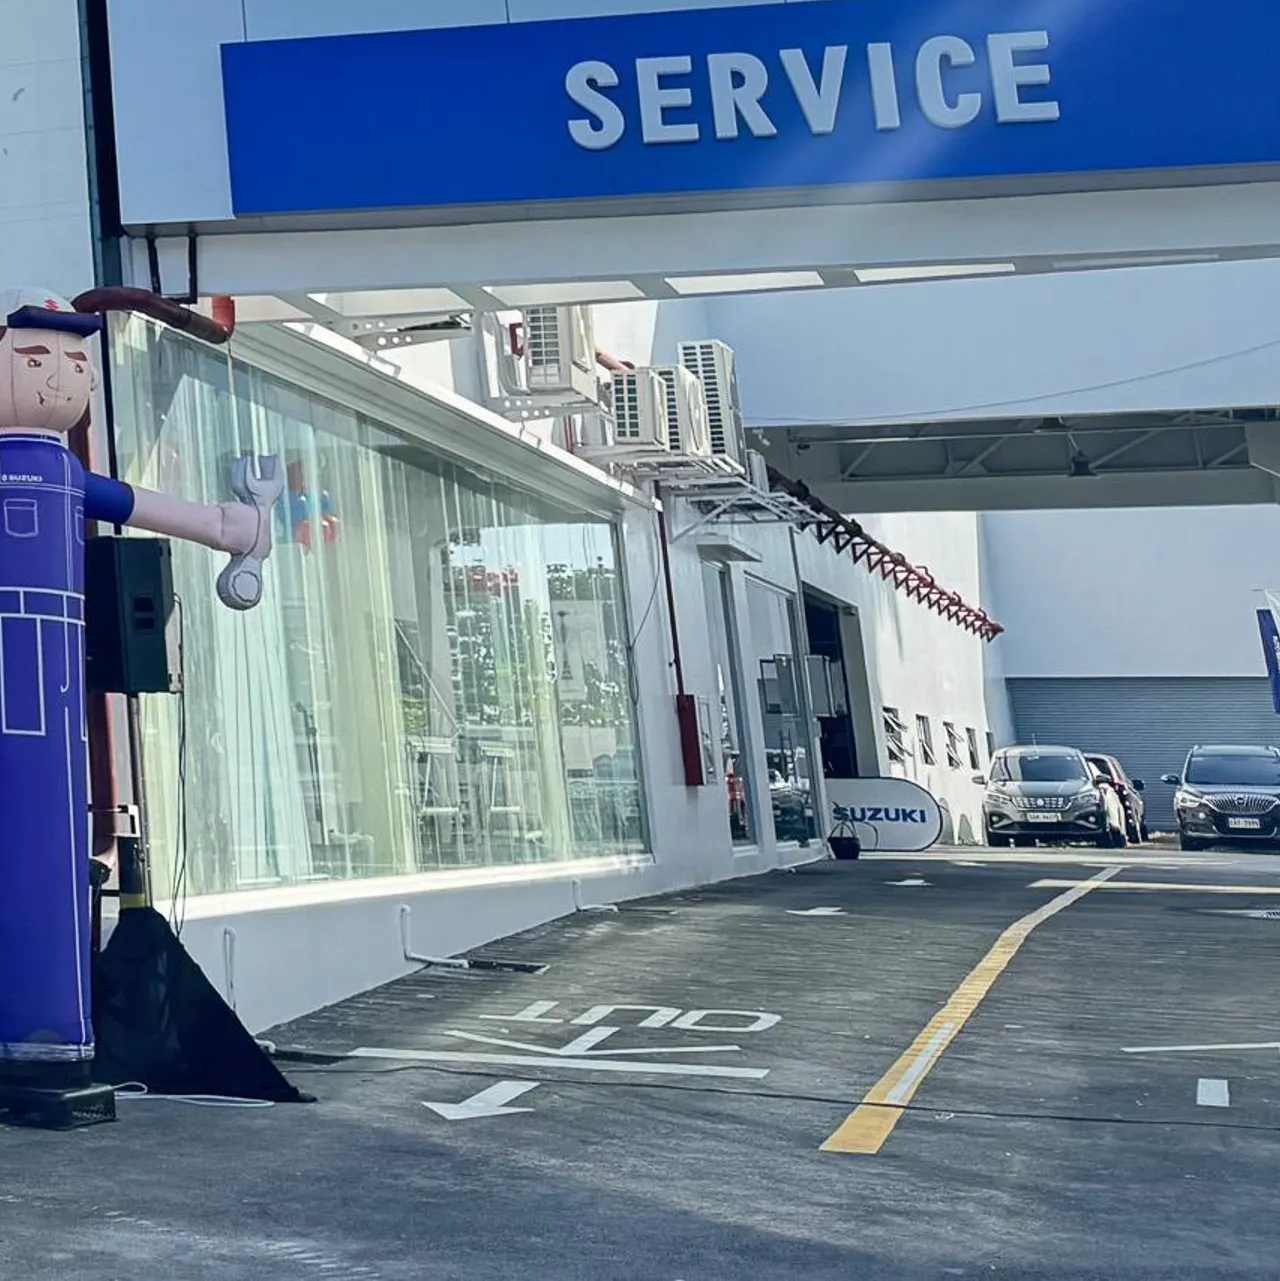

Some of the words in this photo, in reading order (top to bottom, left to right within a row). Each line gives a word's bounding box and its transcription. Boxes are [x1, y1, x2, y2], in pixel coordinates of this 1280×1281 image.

[565, 30, 1060, 150] SERVICE
[833, 805, 927, 824] SUZUKI
[479, 999, 783, 1032] OUT
